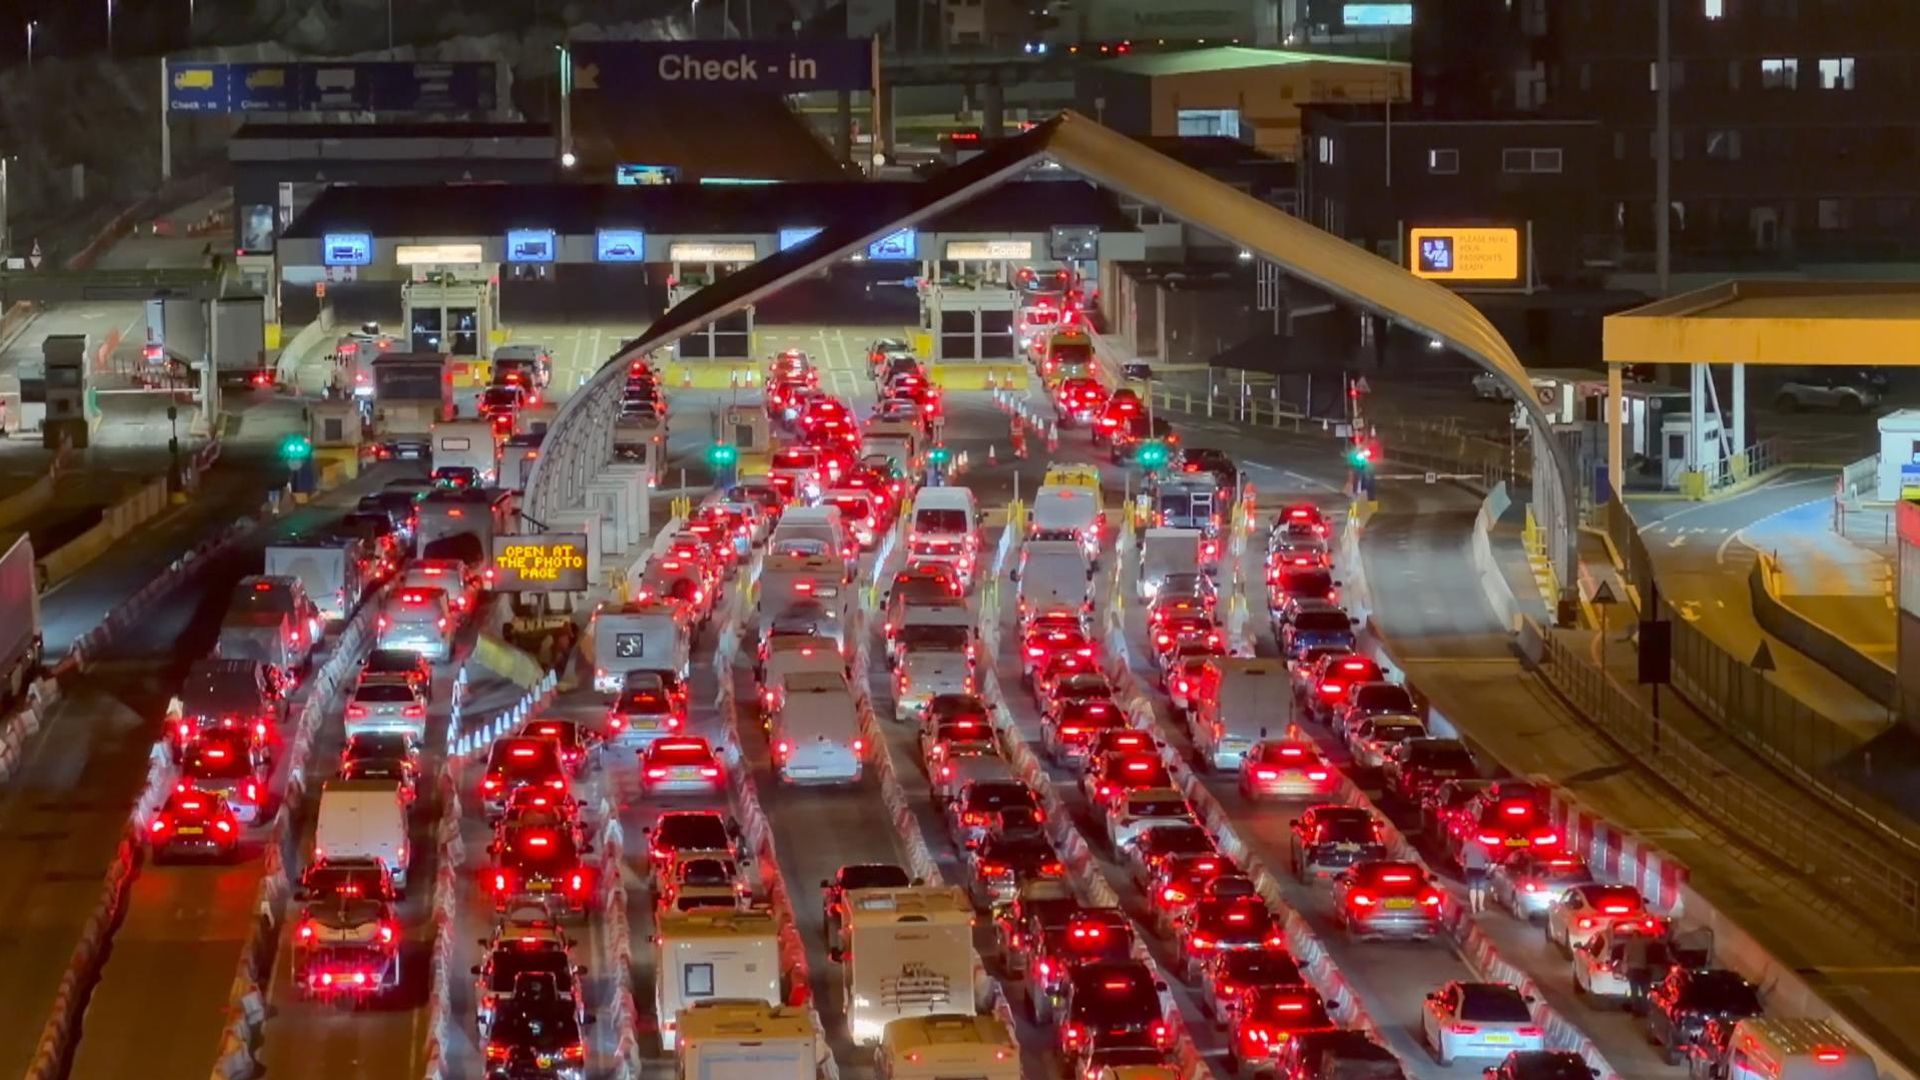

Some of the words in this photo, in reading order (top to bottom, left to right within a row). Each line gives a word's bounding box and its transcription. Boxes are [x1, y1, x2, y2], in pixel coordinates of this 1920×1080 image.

[658, 53, 757, 80] Check
[789, 53, 817, 80] in
[505, 545, 545, 557] OPEN
[553, 544, 574, 557] AT
[497, 556, 527, 568] THE
[534, 556, 583, 568] PHOTO
[520, 567, 557, 579] PAGE
